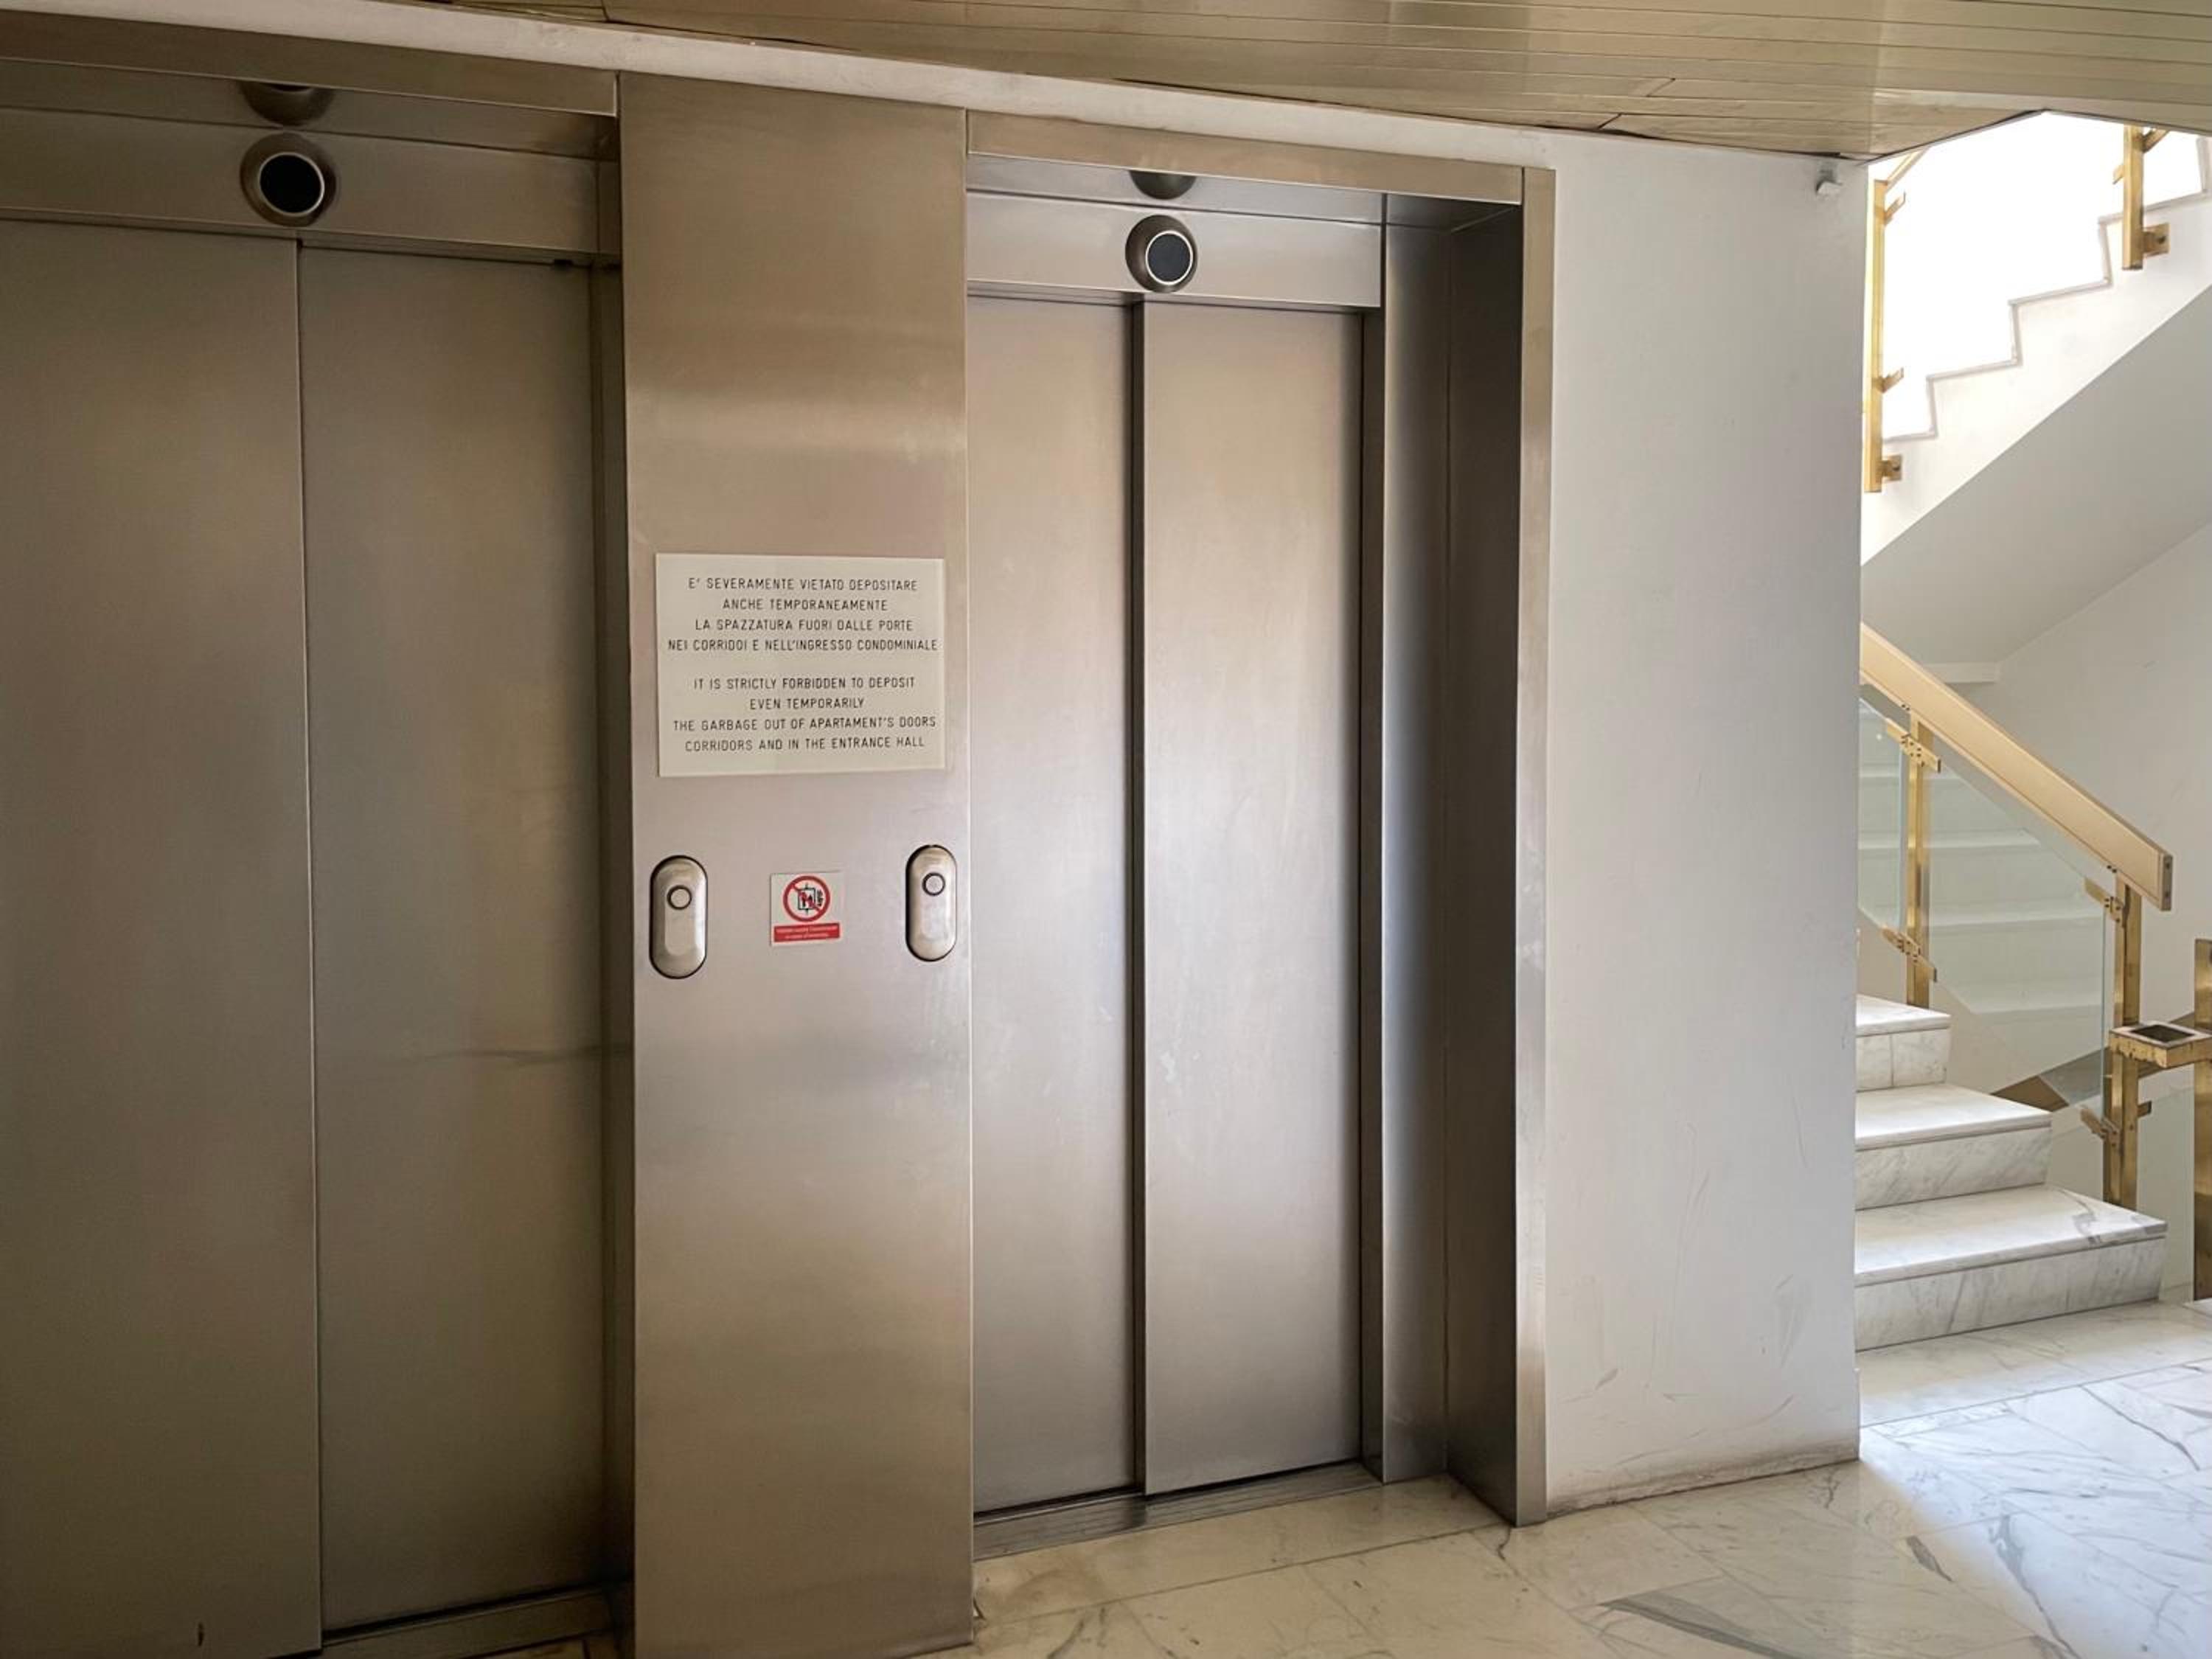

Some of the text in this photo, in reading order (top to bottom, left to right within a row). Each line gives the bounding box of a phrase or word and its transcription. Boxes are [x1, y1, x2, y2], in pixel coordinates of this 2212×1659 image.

[688, 578, 918, 591] E' SEVERAMENTE VIETATO DEPOSITARE
[723, 599, 888, 611] ANCHE TEMPORANEAMENTE
[695, 619, 914, 631] LA SPAZZATURA FUORI DALLE PORTE
[668, 639, 938, 651] NEI CORRIDOI E NELL'INGRESSO CONDOMINIALE
[694, 677, 915, 690] IT IS STRICTLY FORBIDDEN TO DEPOSIT
[750, 698, 864, 710] EVEN TEMPORARILY
[673, 716, 936, 731] THE GARBAGE OUT OF APARTAMENT'S DOORS
[685, 736, 925, 751] CORRIDORS AND IN THE ENTRANCE HALL
